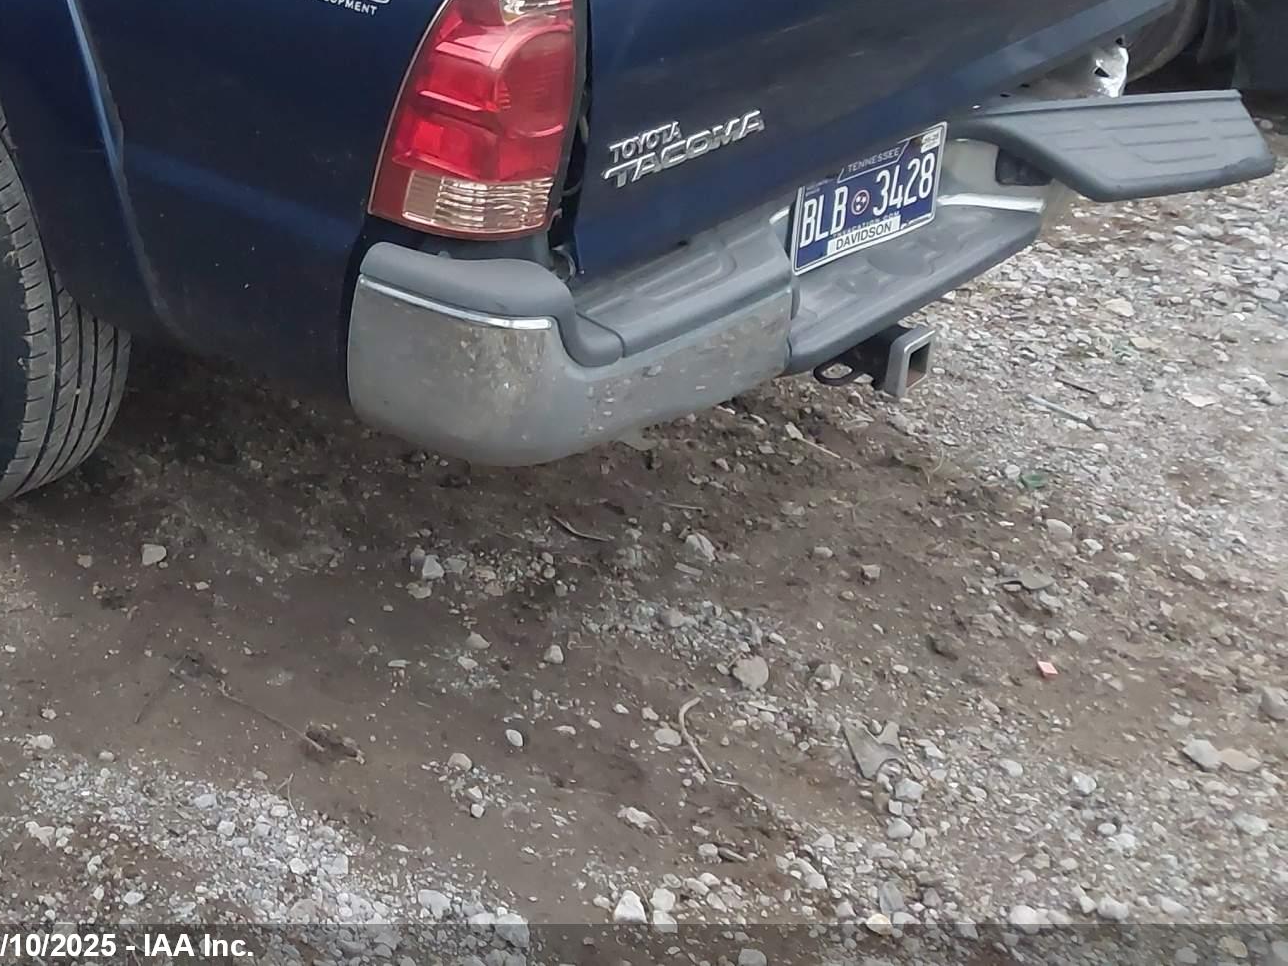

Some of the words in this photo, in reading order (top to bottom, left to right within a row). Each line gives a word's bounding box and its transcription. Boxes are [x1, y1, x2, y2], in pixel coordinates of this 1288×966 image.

[602, 109, 766, 188] TACOMA
[609, 120, 682, 164] TOYOTA
[847, 146, 901, 173] TENNESSEE
[799, 185, 849, 249] BLB
[872, 152, 936, 217] 3428
[835, 221, 892, 251] DAVIDSON
